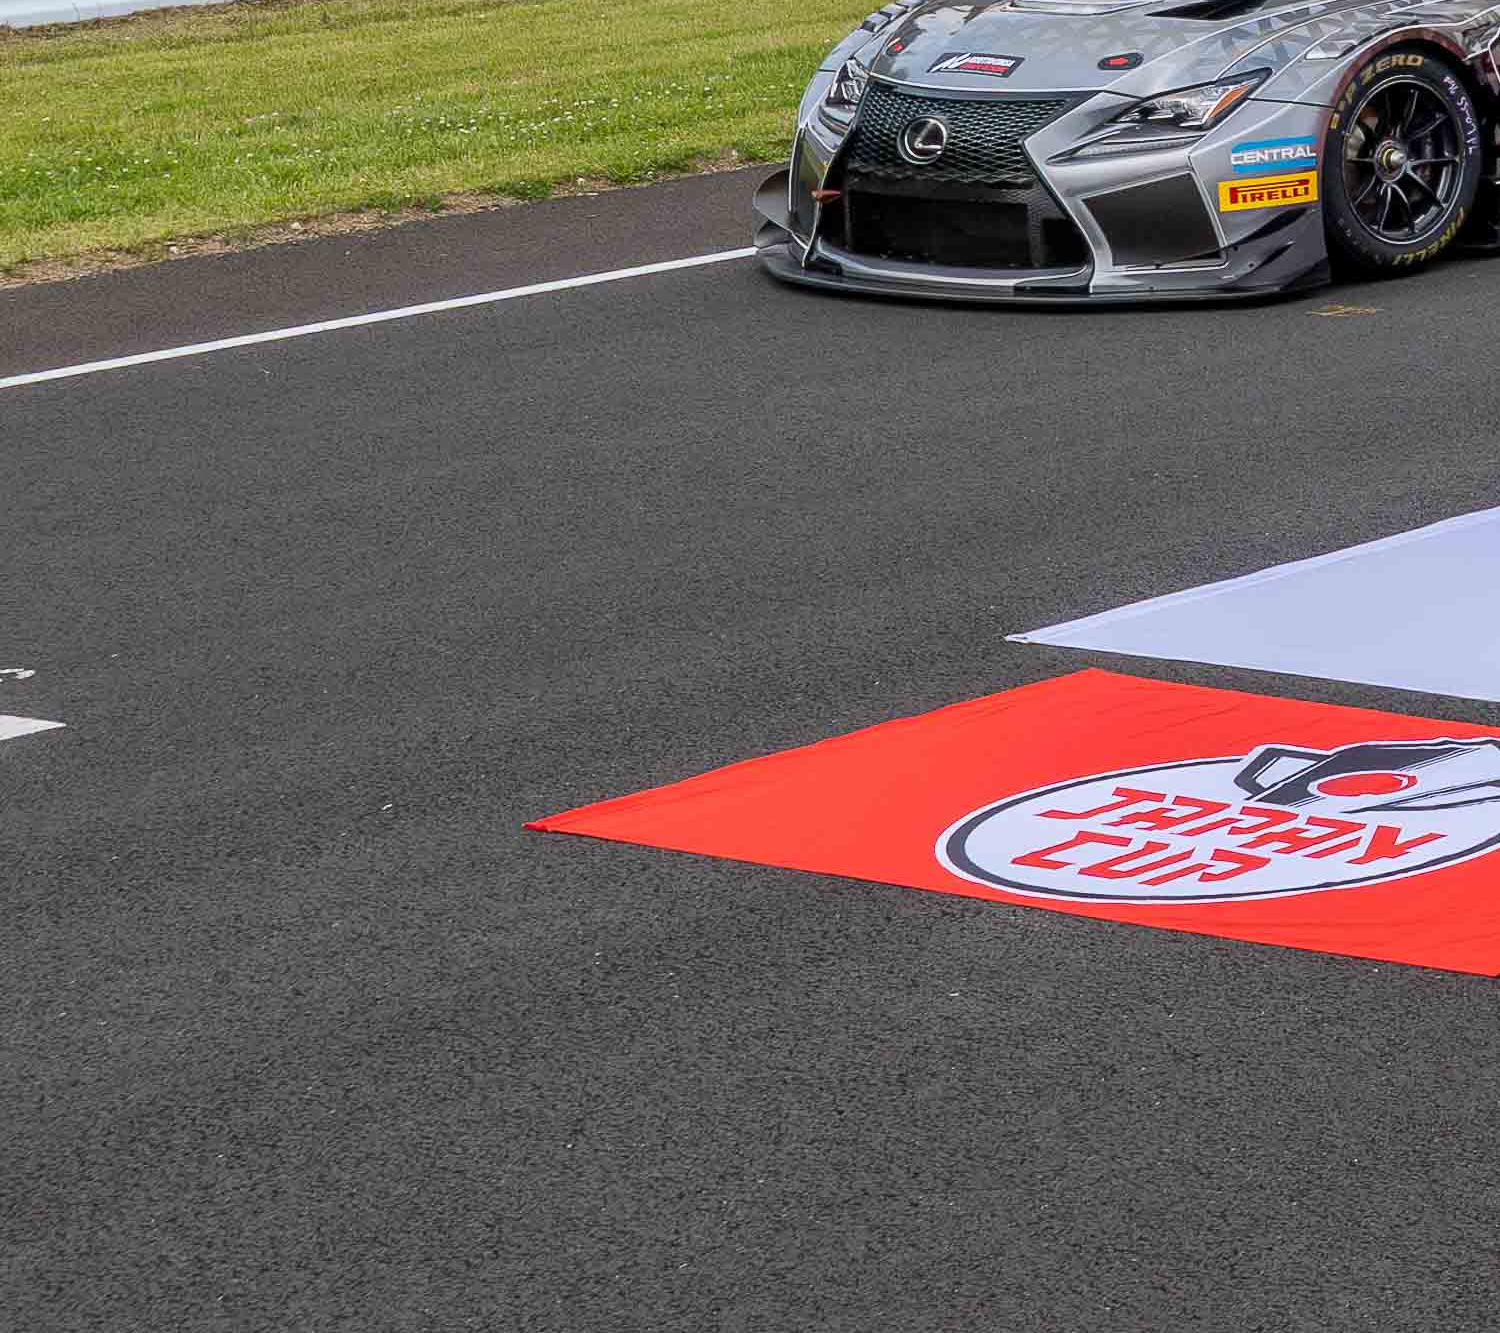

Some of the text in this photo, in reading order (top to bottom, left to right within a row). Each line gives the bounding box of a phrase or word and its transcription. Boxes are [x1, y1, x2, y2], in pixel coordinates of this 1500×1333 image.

[1231, 143, 1317, 167] CENTRAL
[1229, 179, 1311, 205] PIRELLI
[1034, 786, 1446, 865] JAPAN
[1010, 829, 1272, 886] CUP
